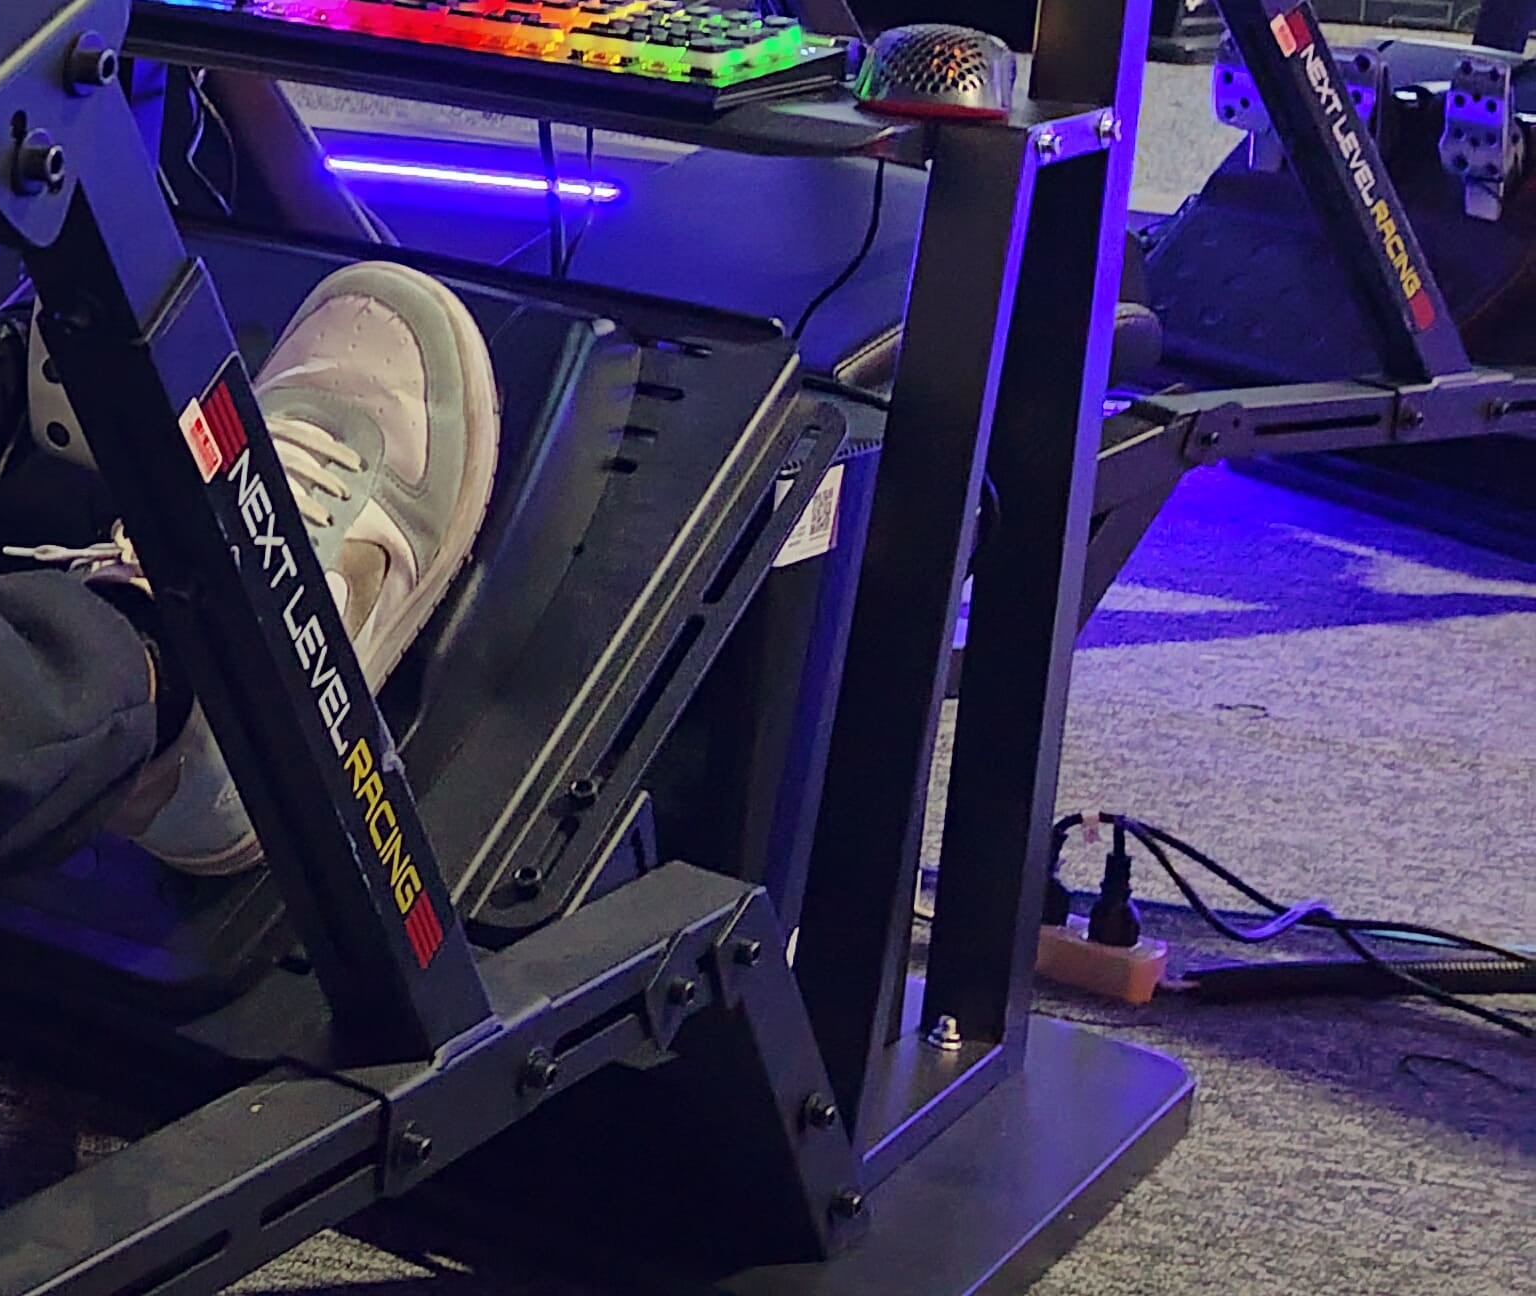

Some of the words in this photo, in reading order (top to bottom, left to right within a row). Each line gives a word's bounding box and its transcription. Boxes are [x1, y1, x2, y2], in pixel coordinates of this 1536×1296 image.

[1299, 42, 1345, 124] NEXT
[1334, 116, 1378, 210] LEVEL
[1369, 196, 1420, 300] RACING
[225, 448, 297, 590] NEXT
[282, 584, 351, 754] LEVEL
[343, 736, 422, 915] RACING
